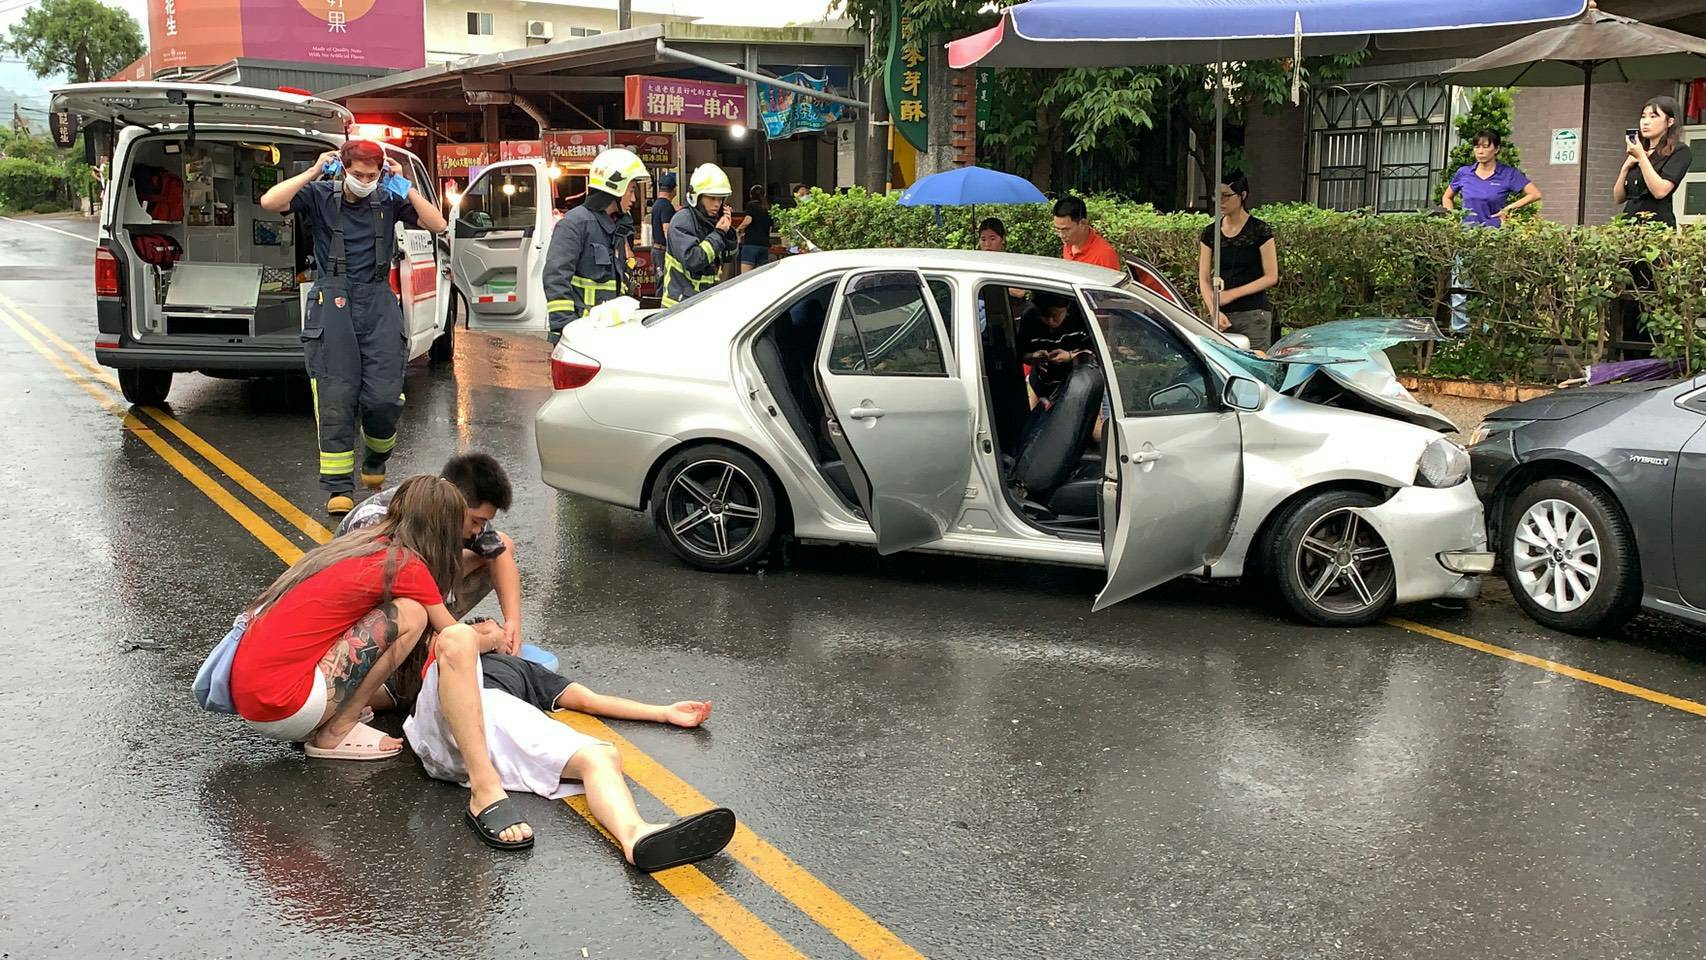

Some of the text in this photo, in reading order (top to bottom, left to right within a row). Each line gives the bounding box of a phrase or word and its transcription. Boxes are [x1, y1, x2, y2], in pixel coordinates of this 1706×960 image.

[647, 92, 740, 120] 招牌一串心
[1554, 150, 1575, 162] 450
